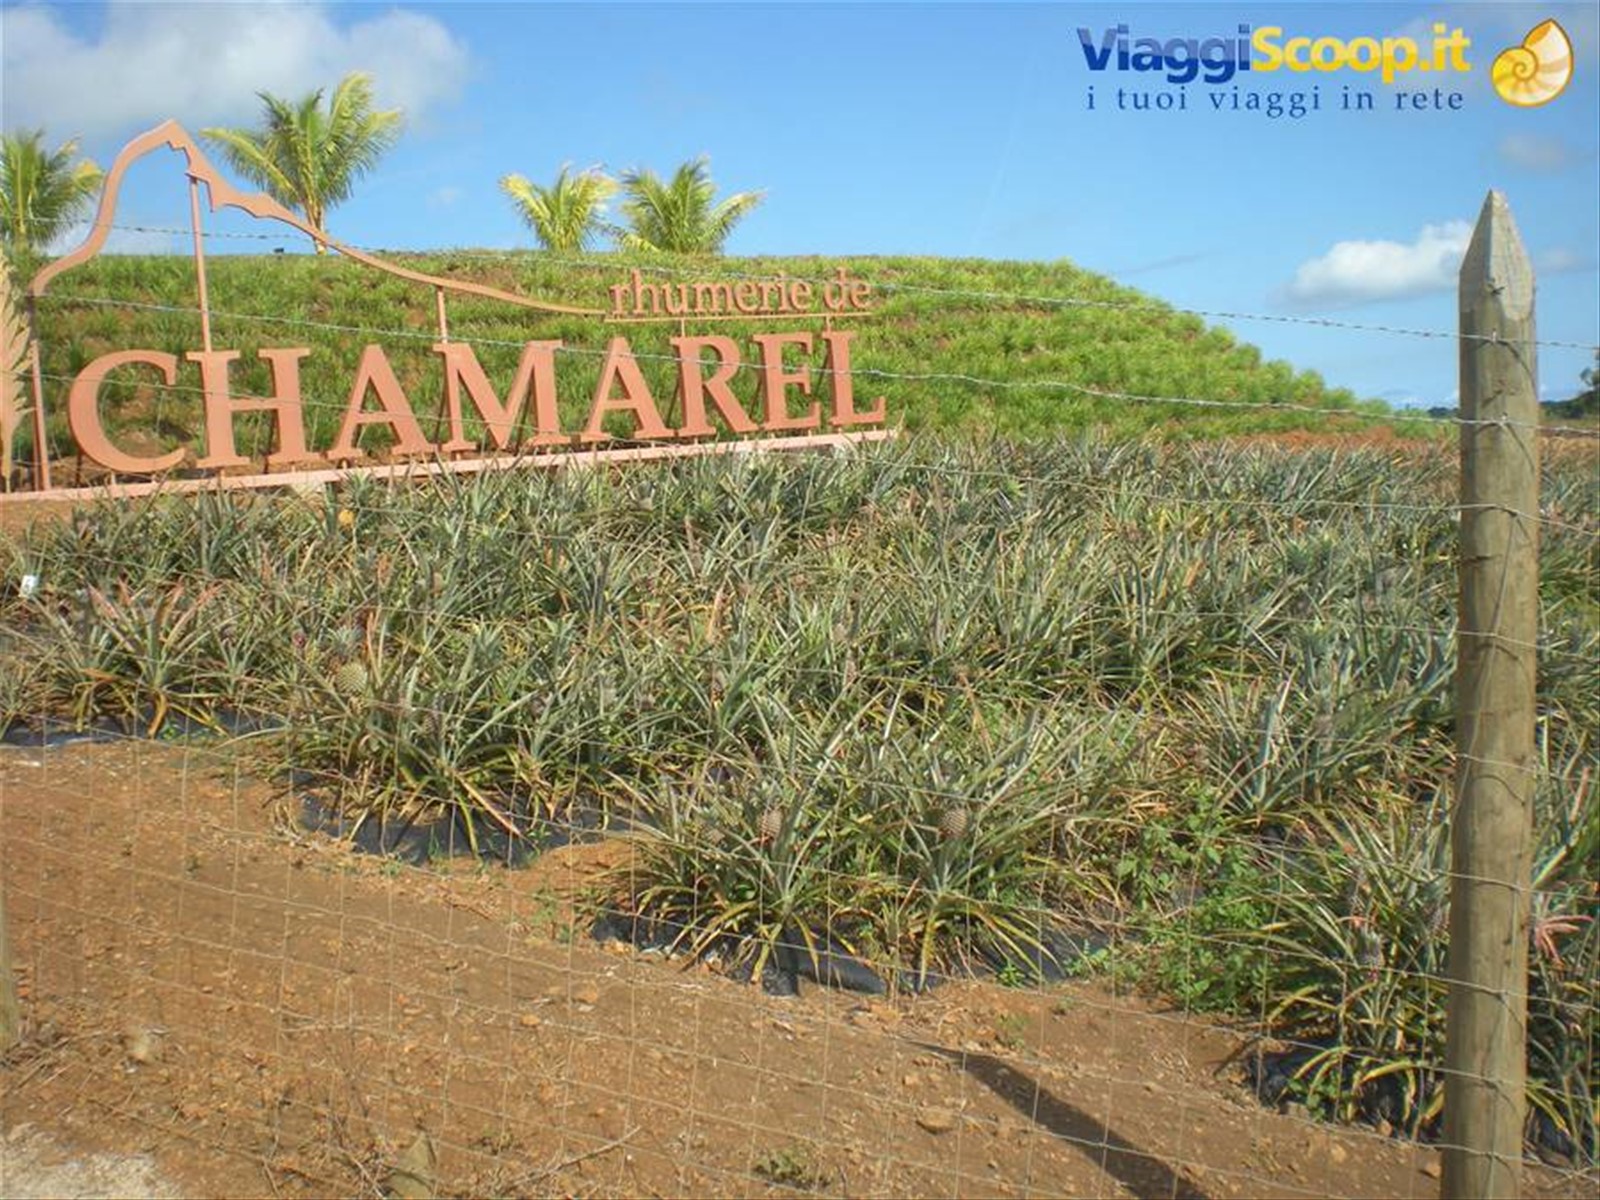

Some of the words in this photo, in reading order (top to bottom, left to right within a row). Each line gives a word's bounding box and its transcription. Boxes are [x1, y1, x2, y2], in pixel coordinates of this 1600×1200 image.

[608, 267, 812, 316] rhumerie
[823, 266, 875, 311] de
[68, 330, 888, 474] CHAMAREL
